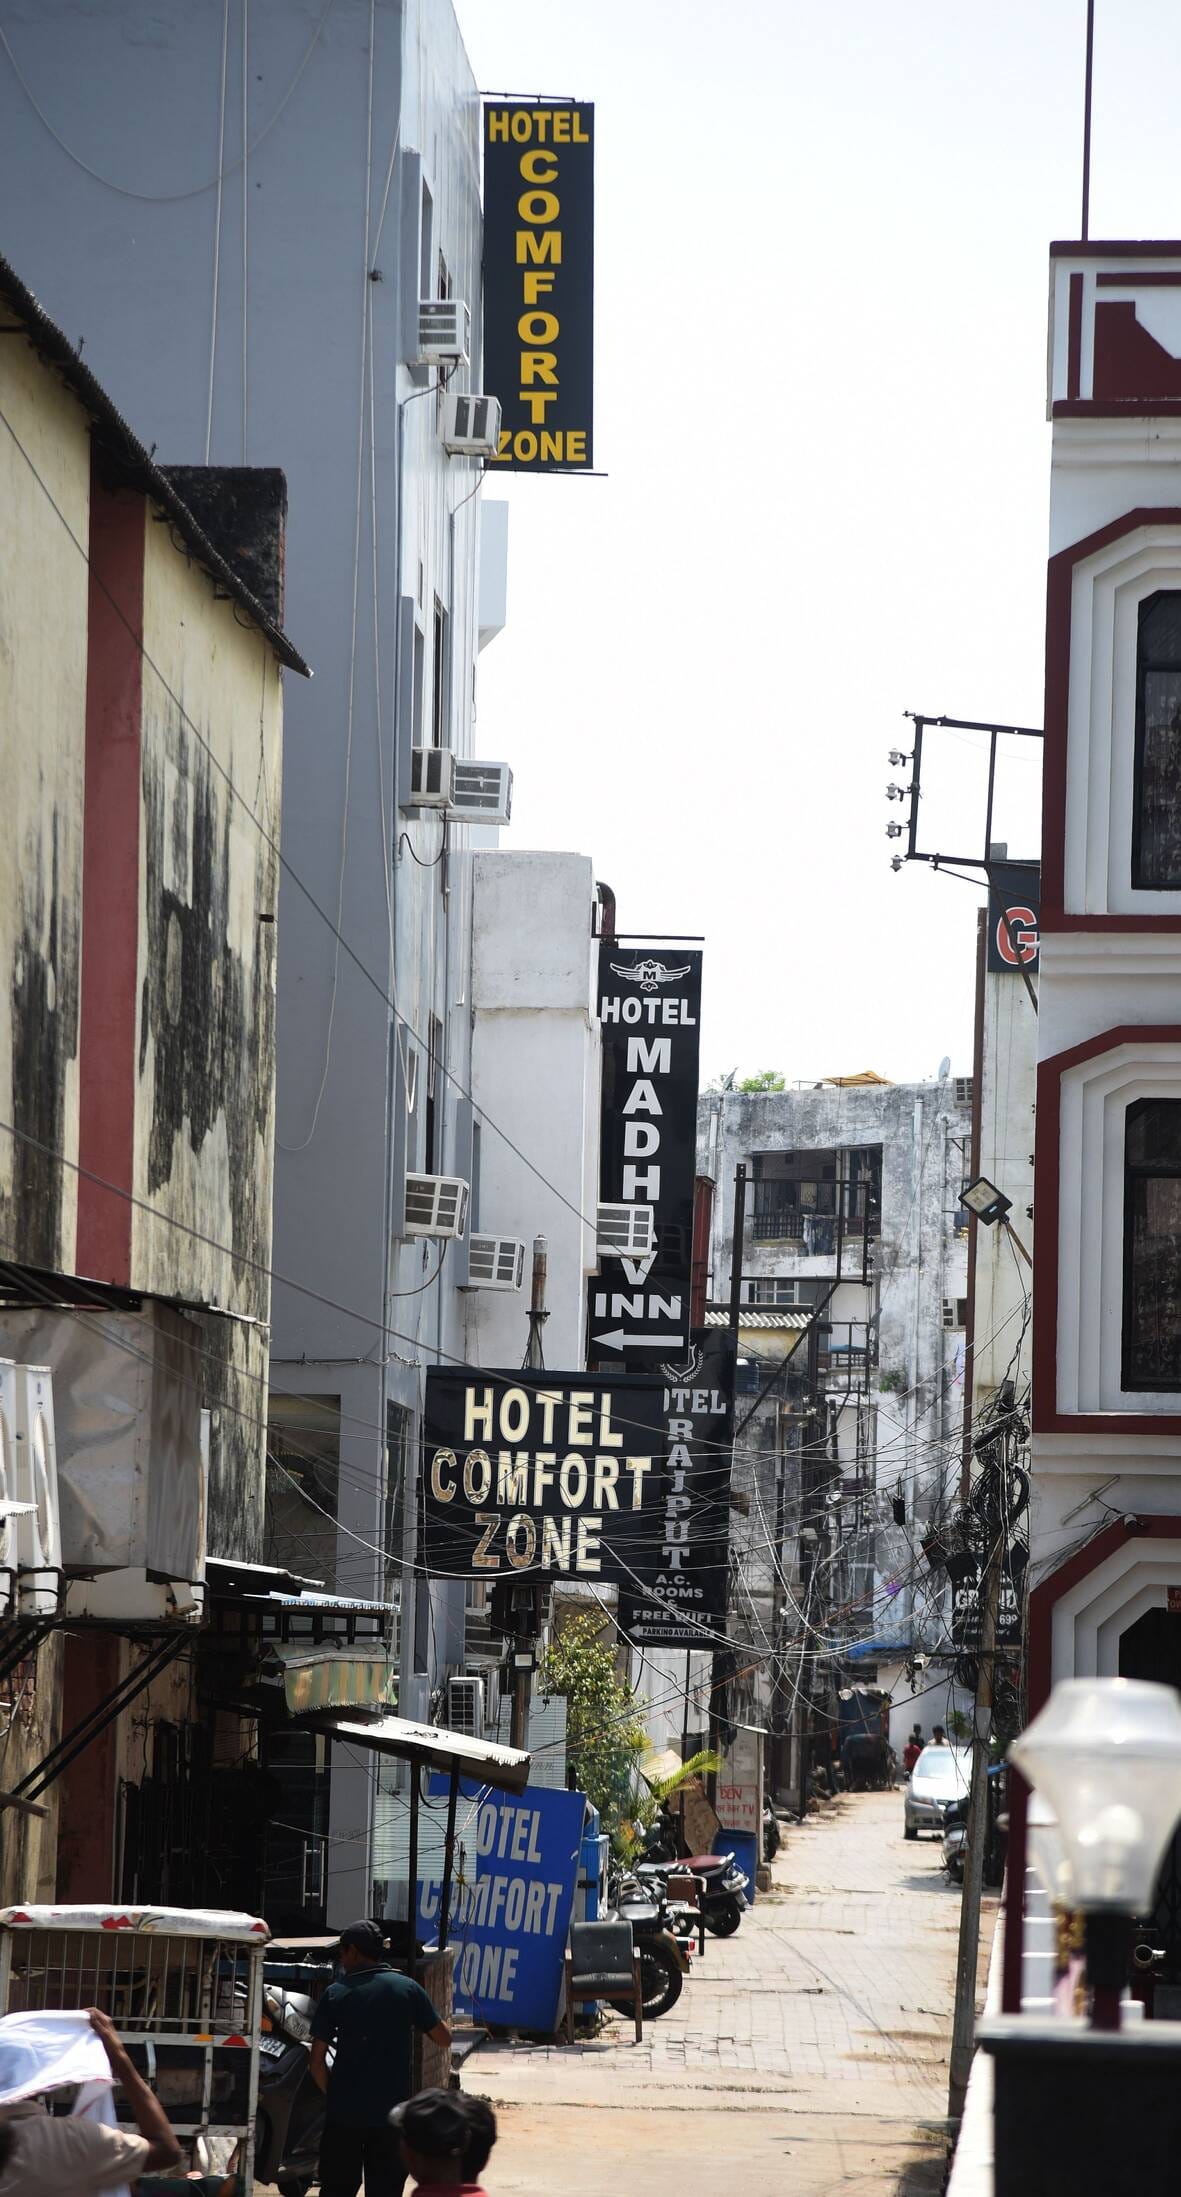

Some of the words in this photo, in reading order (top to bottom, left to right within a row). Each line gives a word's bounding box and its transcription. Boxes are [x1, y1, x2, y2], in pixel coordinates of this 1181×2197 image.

[489, 111, 589, 143] HOTEL
[516, 149, 562, 425] COMFORT
[490, 431, 587, 462] ZONE
[601, 996, 697, 1025] HOTEL
[620, 1036, 671, 1286] MADHV
[595, 1292, 681, 1320] INN
[464, 1386, 624, 1448] HOTEL
[663, 1388, 727, 1414] TEL
[430, 1448, 652, 1511] COMFORT
[662, 1418, 694, 1570] RAJPUT
[471, 1513, 603, 1572] ZONE
[656, 1574, 691, 1585] A.C.
[632, 1610, 671, 1621] FREE
[476, 1803, 541, 1864] OTEL
